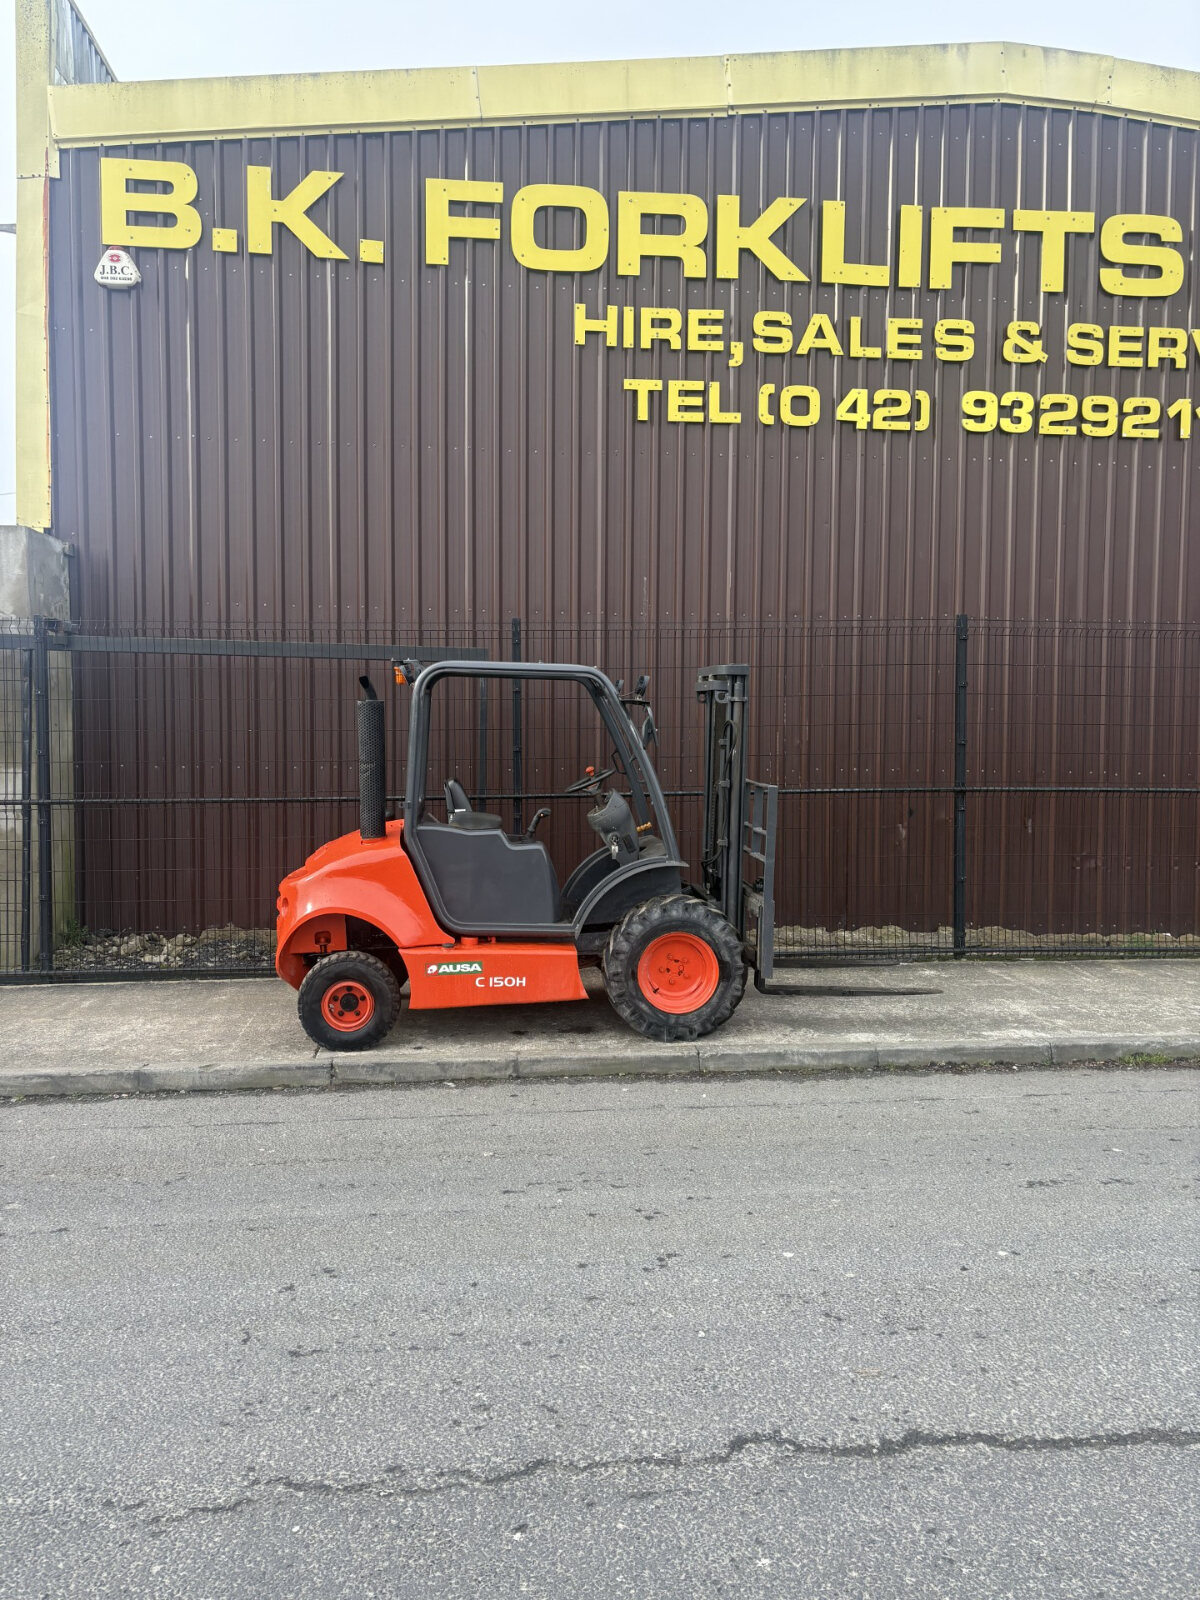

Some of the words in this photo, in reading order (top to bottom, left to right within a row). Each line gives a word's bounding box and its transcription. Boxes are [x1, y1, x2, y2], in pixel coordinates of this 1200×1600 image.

[101, 157, 384, 263] B.K.
[426, 178, 1184, 296] FORKLIFTS
[99, 264, 133, 276] J.B.C.
[1003, 320, 1048, 363] &
[1066, 323, 1200, 368] SER
[624, 379, 741, 423] TEL
[961, 391, 1200, 438] 932921
[438, 963, 482, 973] AUSA
[475, 976, 485, 987] C
